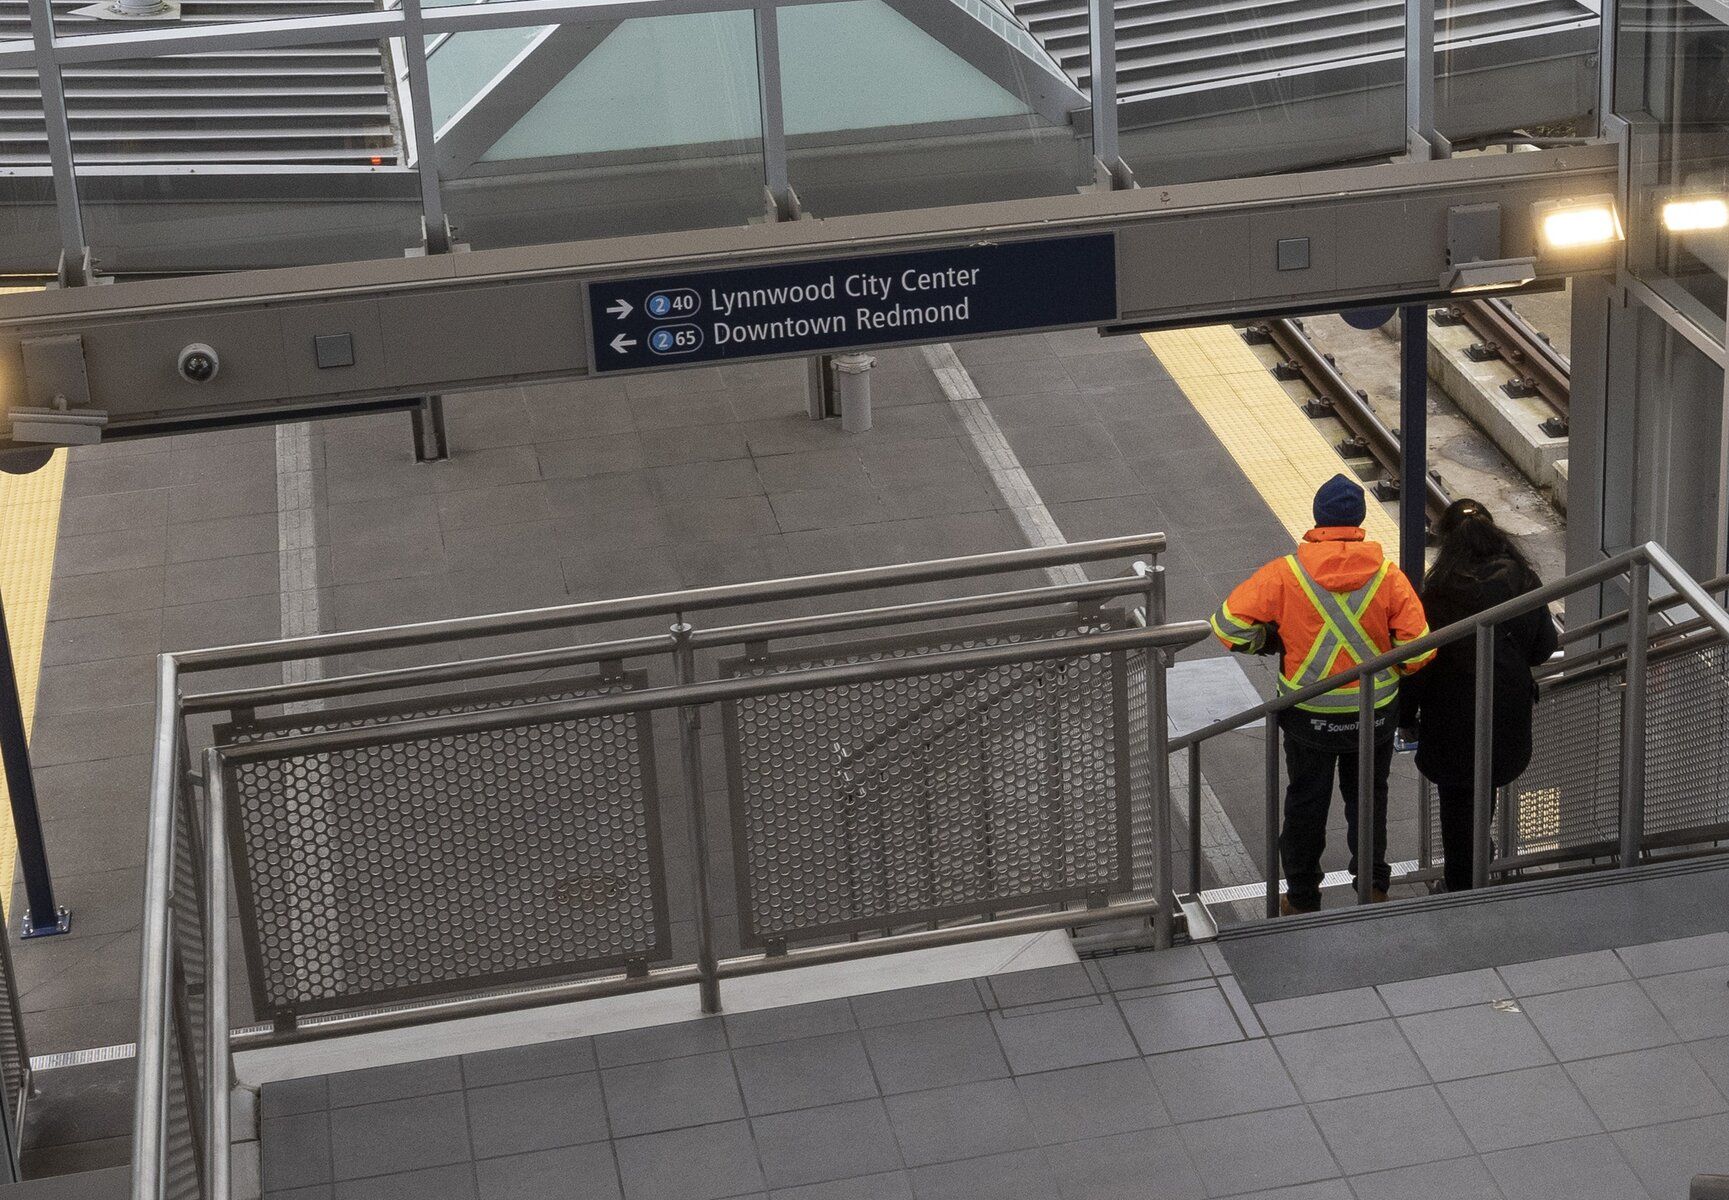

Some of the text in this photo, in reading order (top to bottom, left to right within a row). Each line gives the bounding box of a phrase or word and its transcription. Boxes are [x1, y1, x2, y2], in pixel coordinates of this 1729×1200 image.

[655, 267, 980, 316] 2 40 Lynnwood City Center
[658, 296, 969, 348] 2 65 Downtown Redmond
